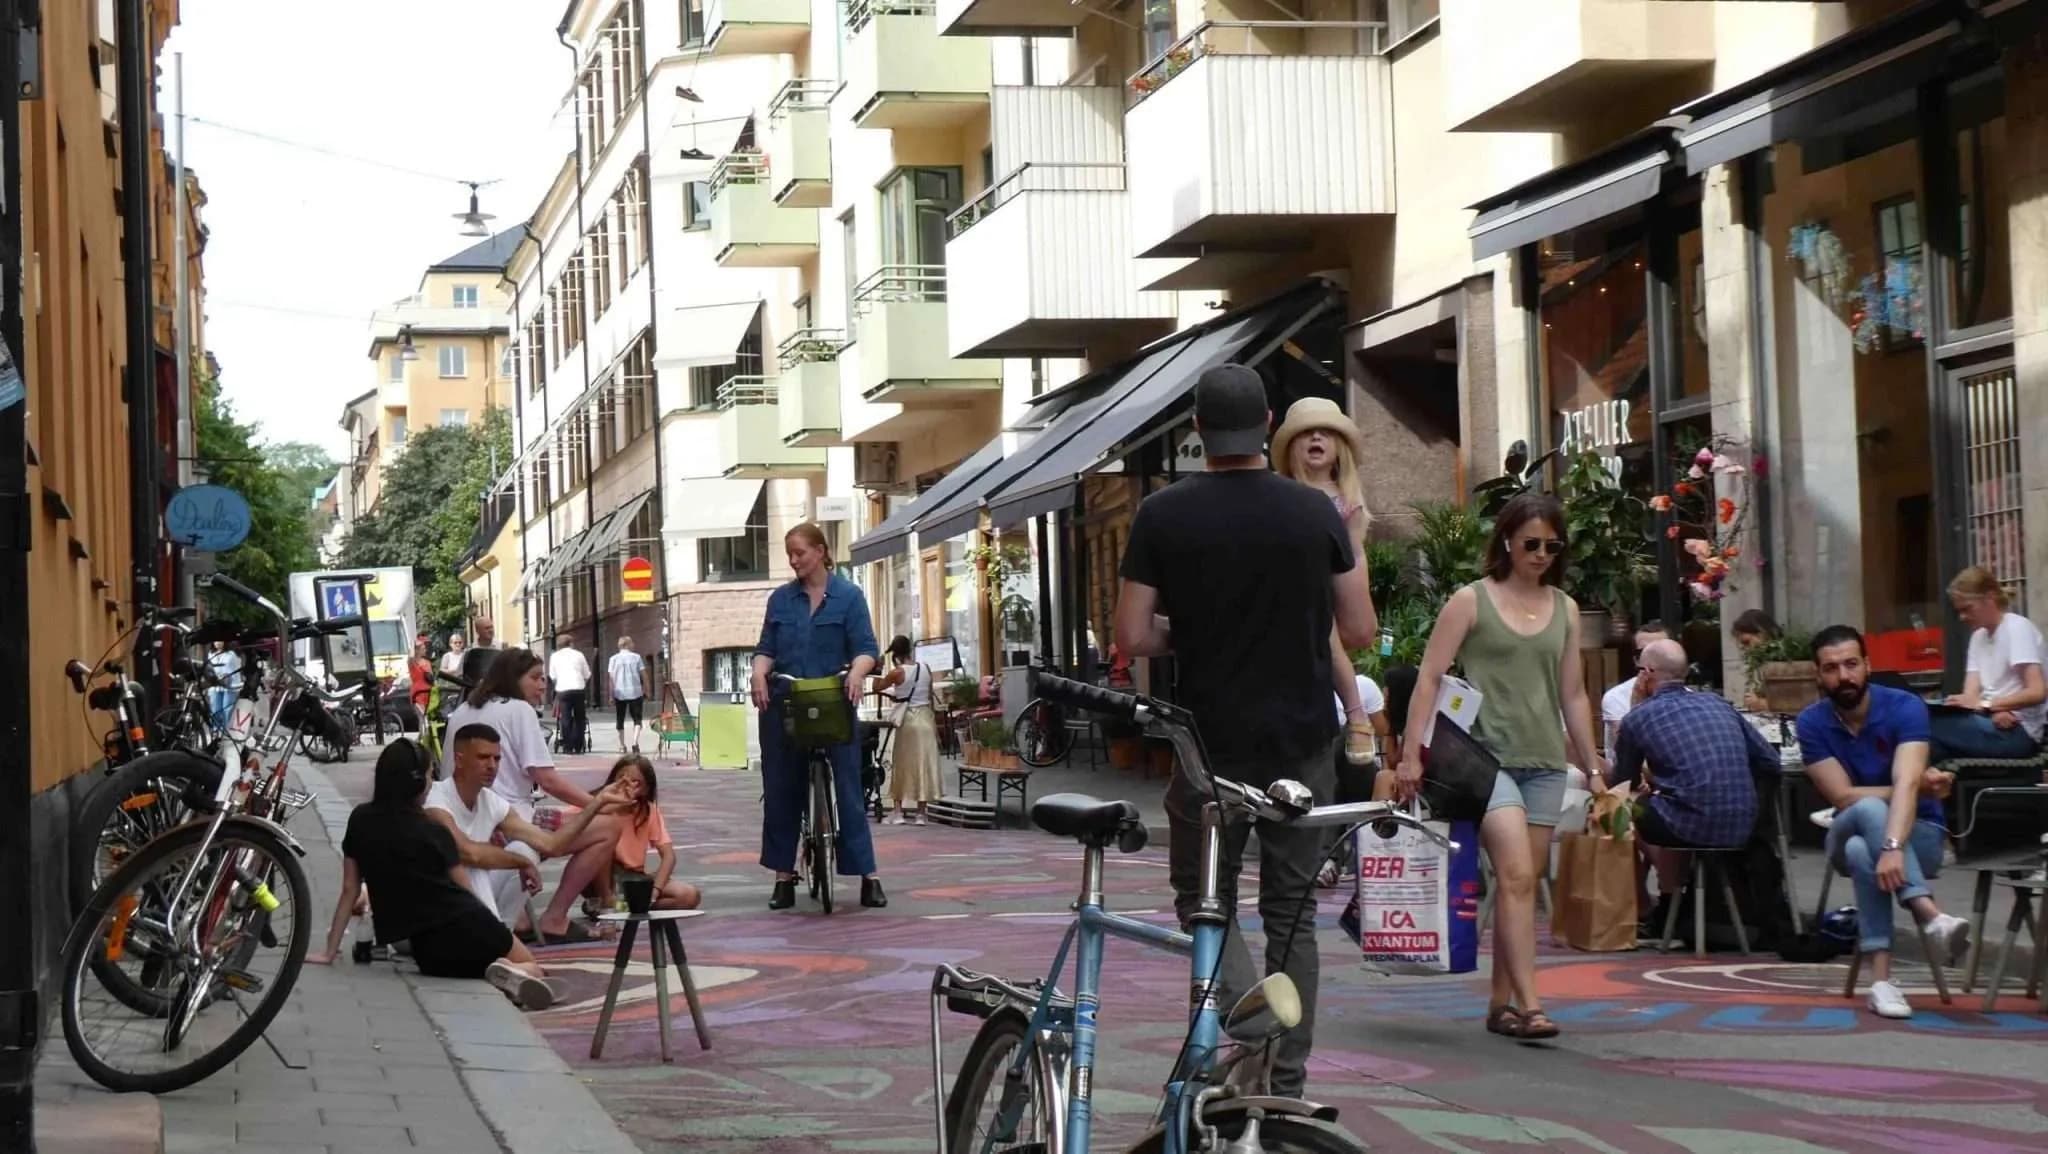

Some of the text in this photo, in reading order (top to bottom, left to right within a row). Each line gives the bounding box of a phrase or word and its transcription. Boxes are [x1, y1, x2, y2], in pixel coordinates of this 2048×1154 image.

[1560, 399, 1632, 456] ATELIER
[1382, 910, 1416, 928] ICA
[1364, 935, 1436, 948] KVANTUM
